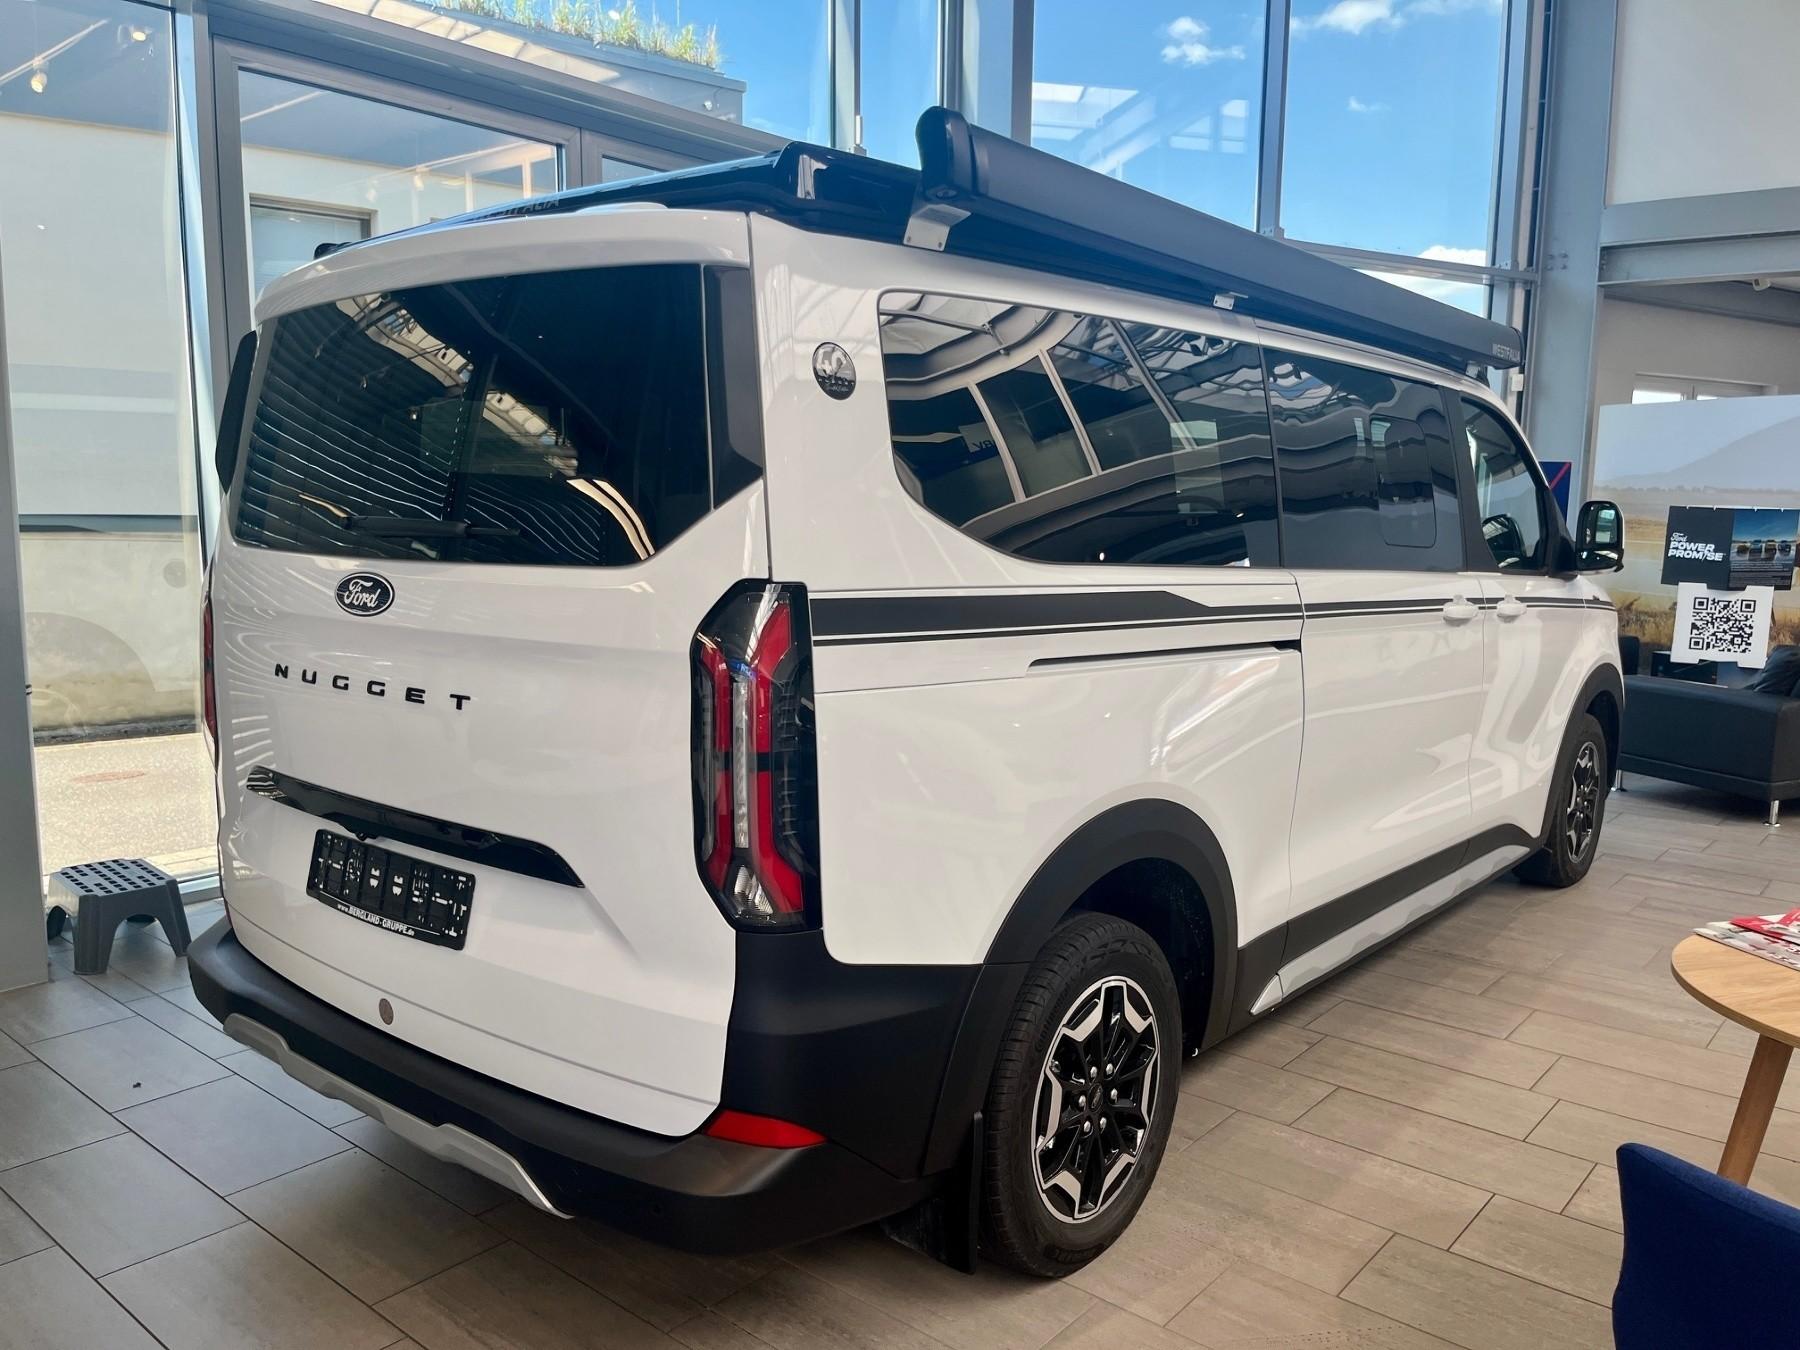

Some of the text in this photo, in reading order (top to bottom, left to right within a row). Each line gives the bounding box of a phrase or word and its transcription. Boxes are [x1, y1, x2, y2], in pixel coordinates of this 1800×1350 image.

[1670, 541, 1716, 552] POWER
[1671, 532, 1688, 542] Ford
[343, 578, 382, 608] Ford
[274, 663, 471, 711] NUGGET
